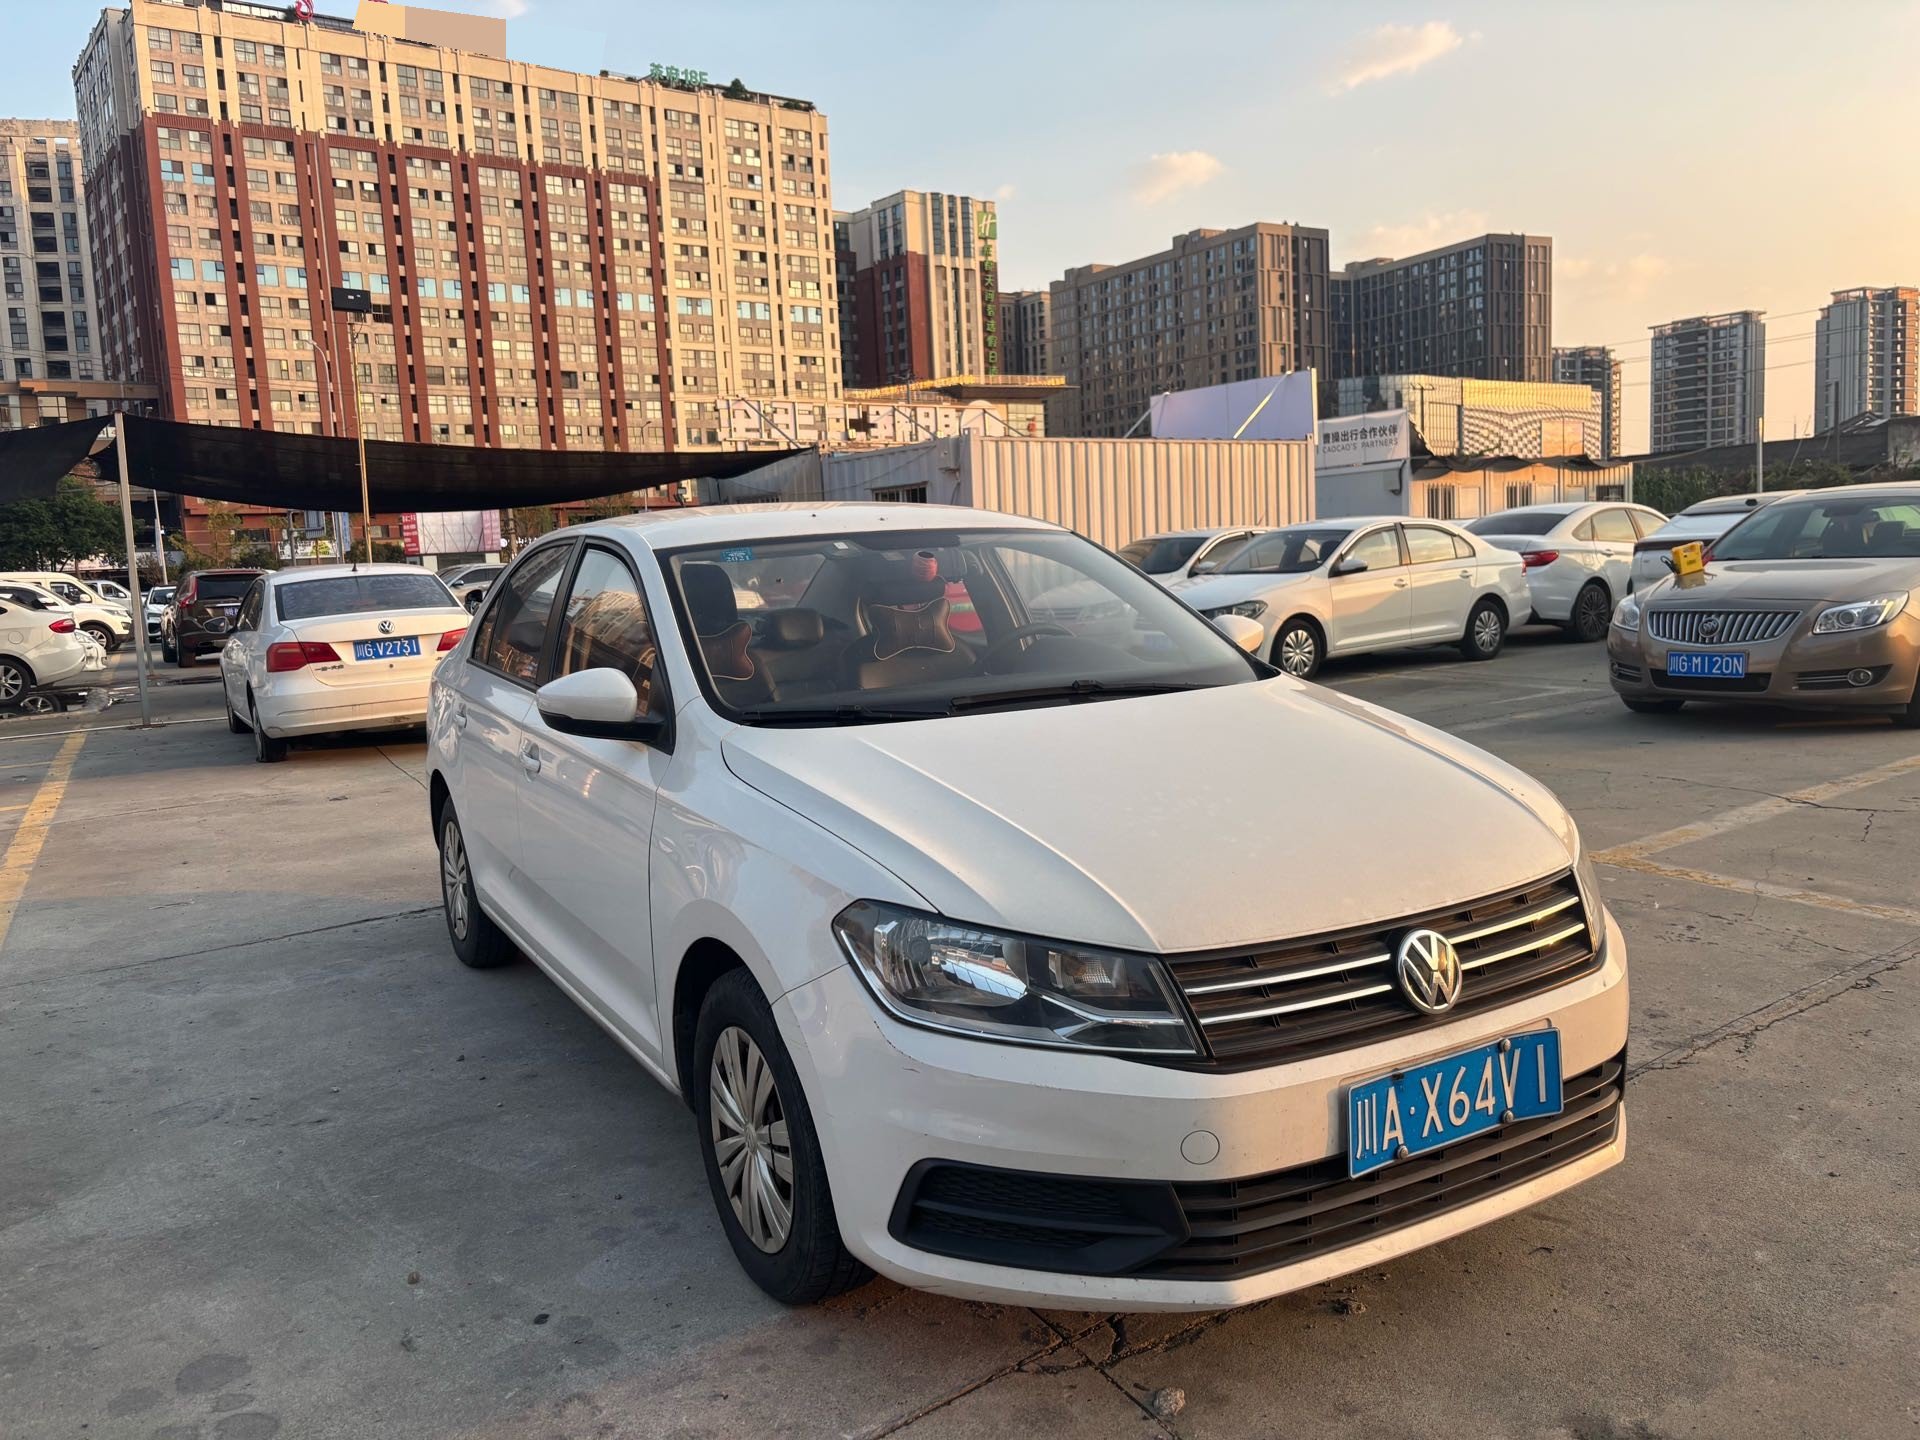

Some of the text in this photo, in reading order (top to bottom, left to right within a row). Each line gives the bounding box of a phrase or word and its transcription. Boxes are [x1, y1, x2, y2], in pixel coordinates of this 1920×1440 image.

[1323, 424, 1398, 444] 曹操出行合作伙伴
[1361, 437, 1398, 449] PARTNERS
